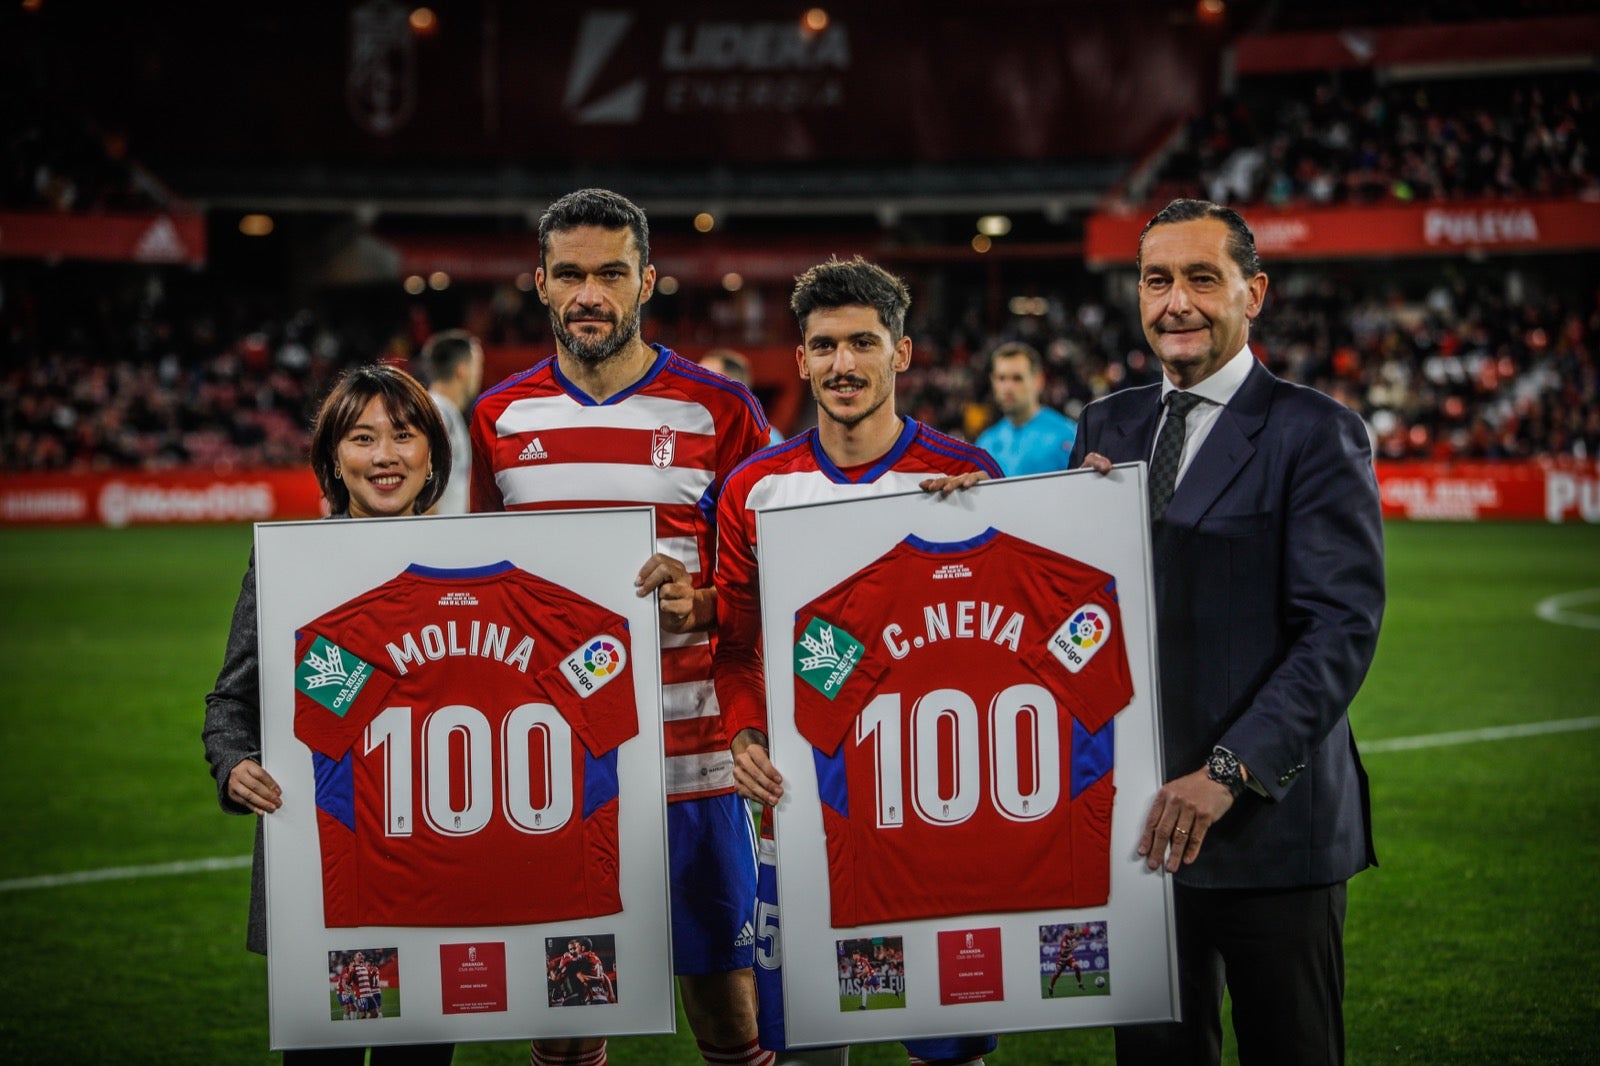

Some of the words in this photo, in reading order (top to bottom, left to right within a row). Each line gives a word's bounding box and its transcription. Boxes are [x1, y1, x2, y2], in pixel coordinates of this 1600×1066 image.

[518, 451, 548, 461] adidas
[385, 620, 535, 676] MOLINA
[882, 601, 1025, 660] C.NEVA
[1054, 634, 1082, 664] LaLiga
[333, 688, 349, 708] CAJA
[345, 660, 368, 689] RURAL
[346, 673, 367, 702] GRANADA
[567, 658, 593, 691] LaLiga
[824, 671, 840, 691] CAJA
[836, 644, 858, 671] RURAL
[364, 702, 574, 838] 100
[855, 683, 1061, 829] 100
